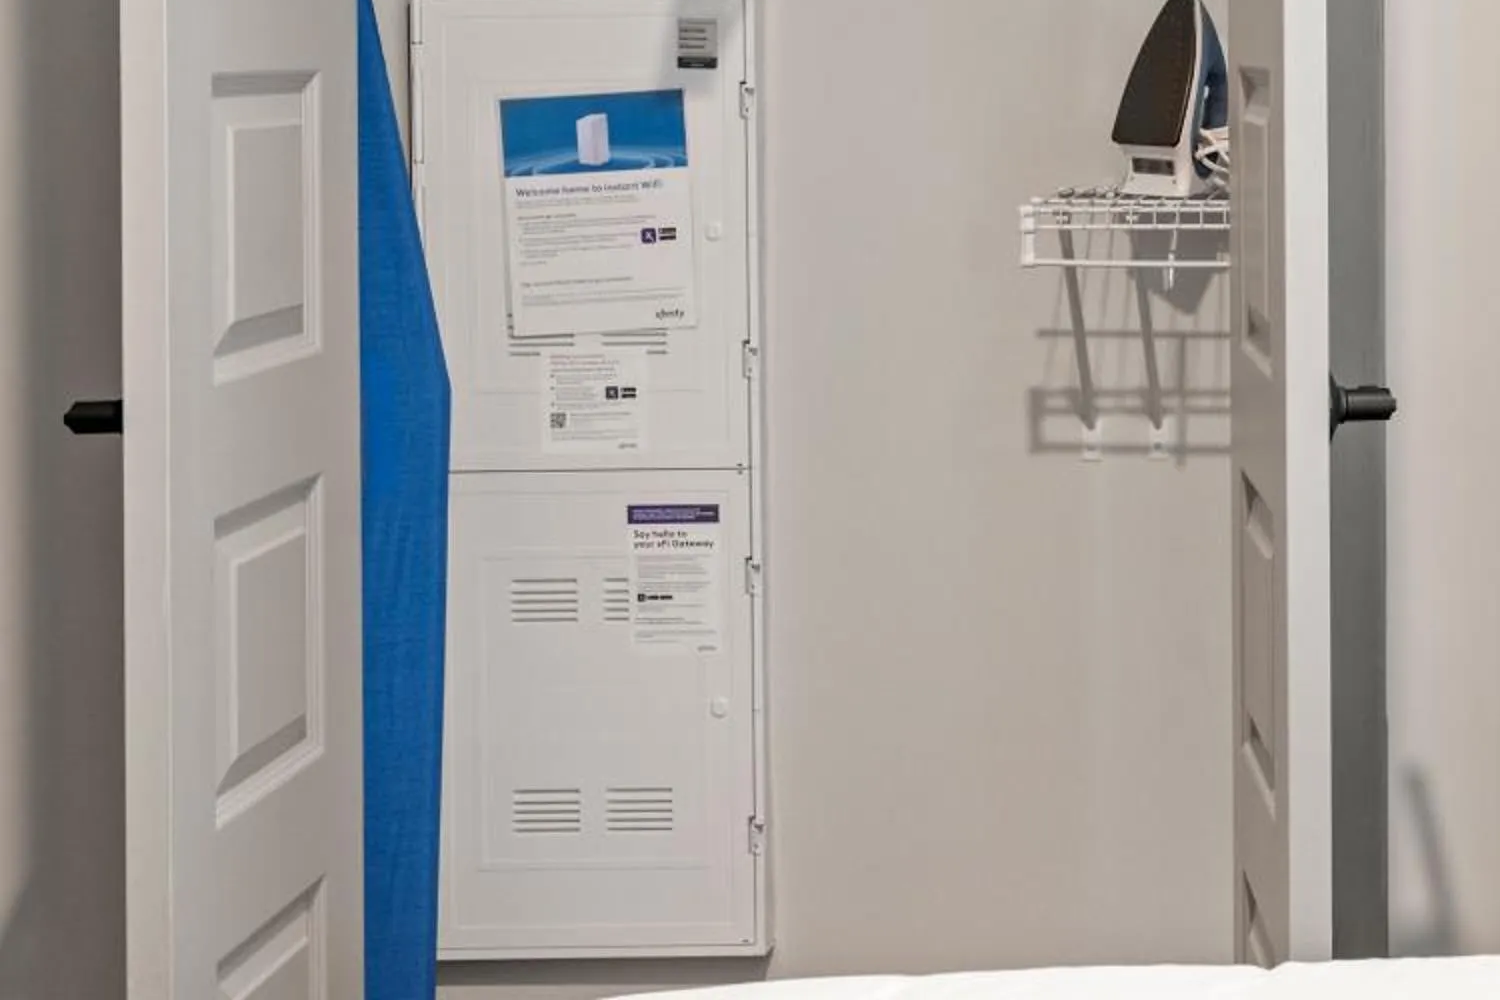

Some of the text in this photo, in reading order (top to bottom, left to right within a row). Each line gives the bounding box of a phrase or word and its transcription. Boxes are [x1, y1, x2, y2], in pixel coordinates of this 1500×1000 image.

[515, 186, 560, 198] Welcome
[562, 185, 589, 194] home
[591, 183, 602, 193] to
[634, 529, 688, 540] Say hello to
[634, 541, 655, 549] your
[672, 539, 714, 549] Gateway
